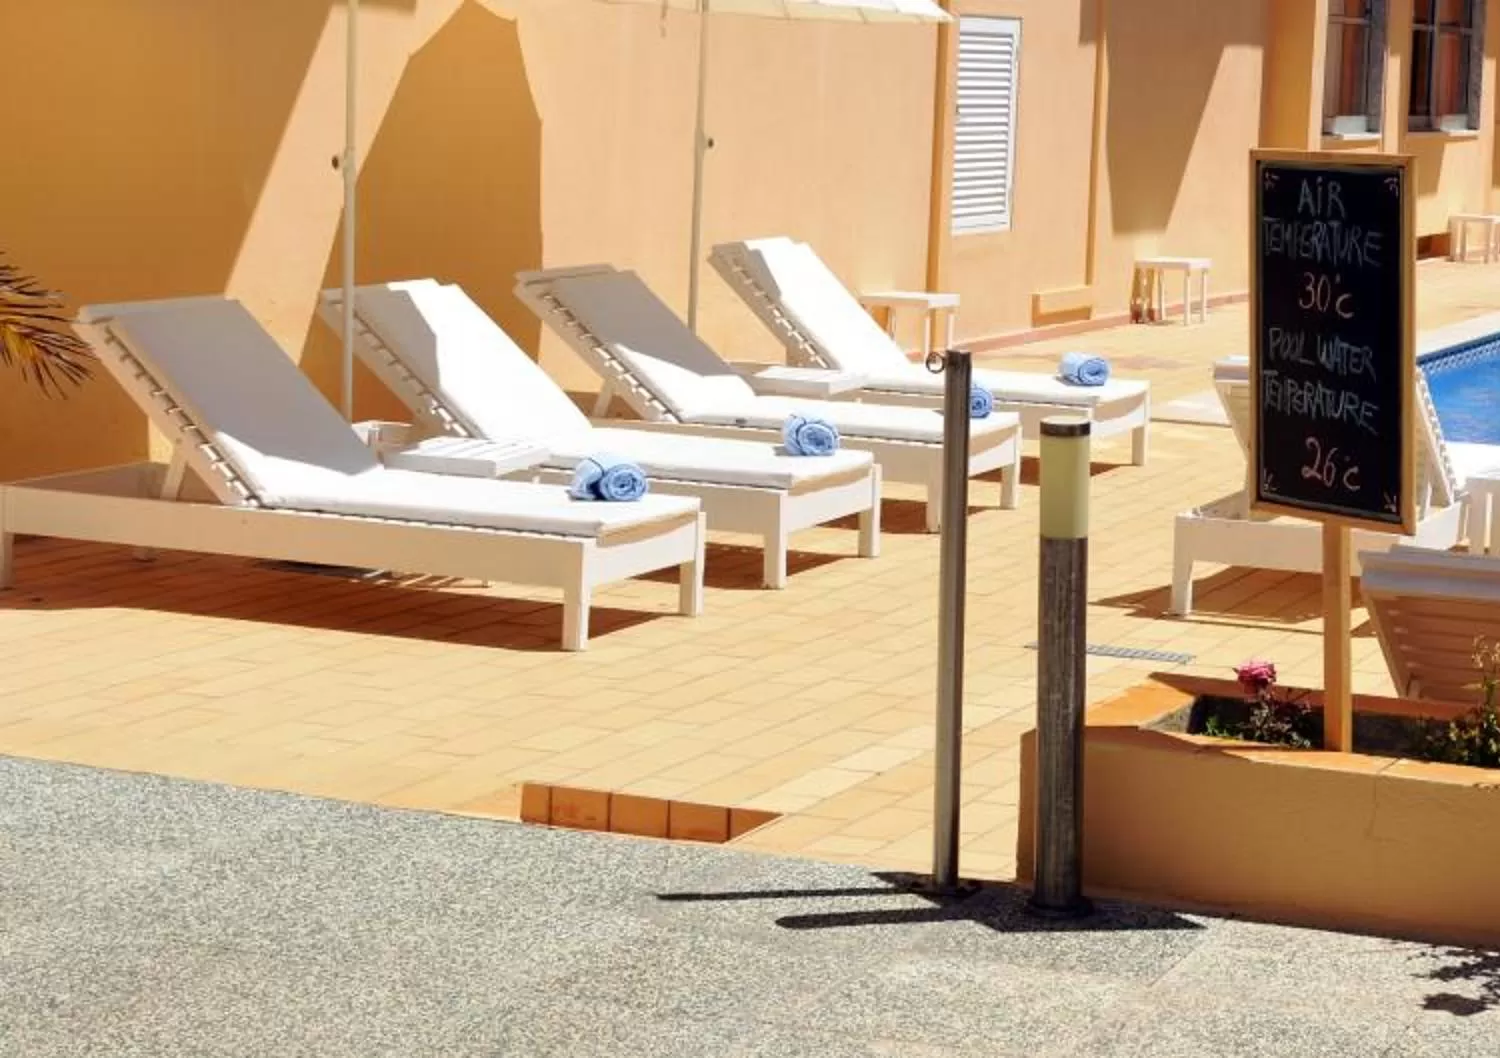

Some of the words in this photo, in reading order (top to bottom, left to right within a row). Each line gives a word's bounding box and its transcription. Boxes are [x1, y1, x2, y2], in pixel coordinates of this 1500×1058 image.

[1263, 217, 1383, 267] TEMPERATURE
[1268, 328, 1315, 366] POOL
[1316, 335, 1377, 383] WATER
